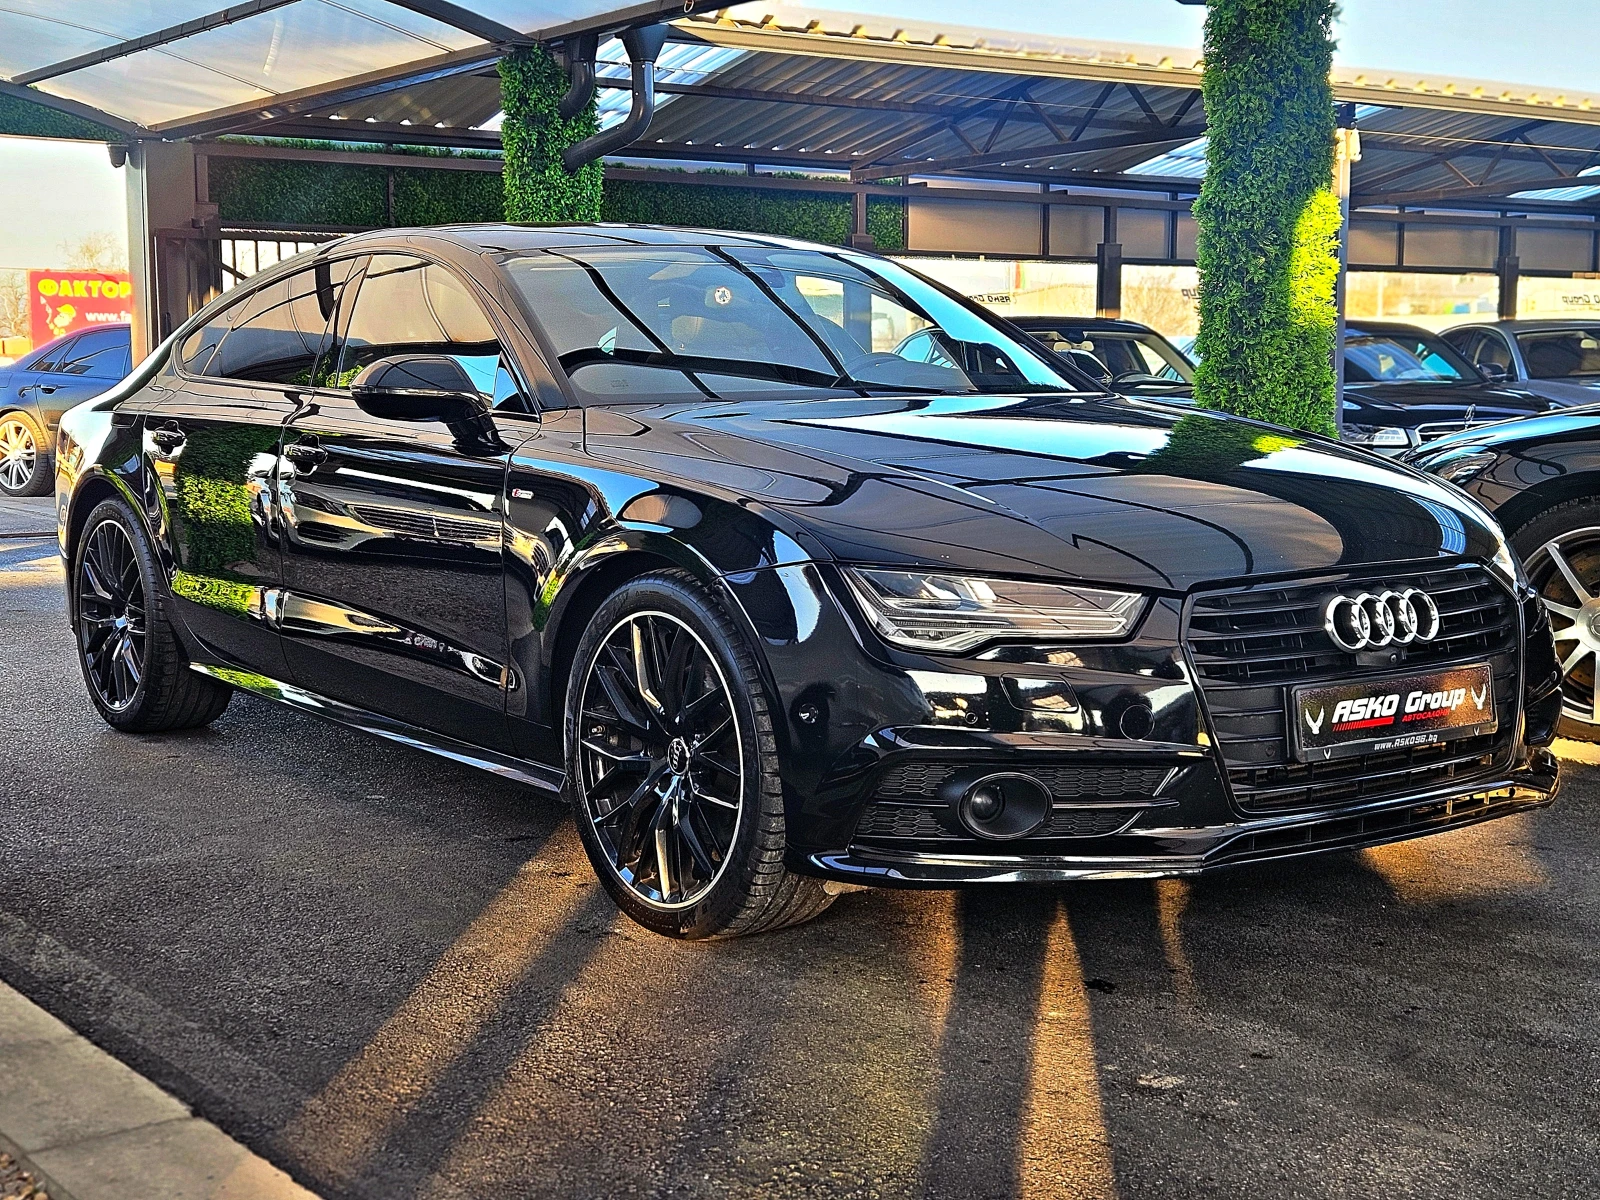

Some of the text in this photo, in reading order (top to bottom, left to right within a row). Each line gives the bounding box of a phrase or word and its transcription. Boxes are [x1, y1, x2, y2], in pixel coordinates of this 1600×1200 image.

[38, 278, 131, 298] ФАКТОР
[1331, 688, 1466, 724] ASKO Group
